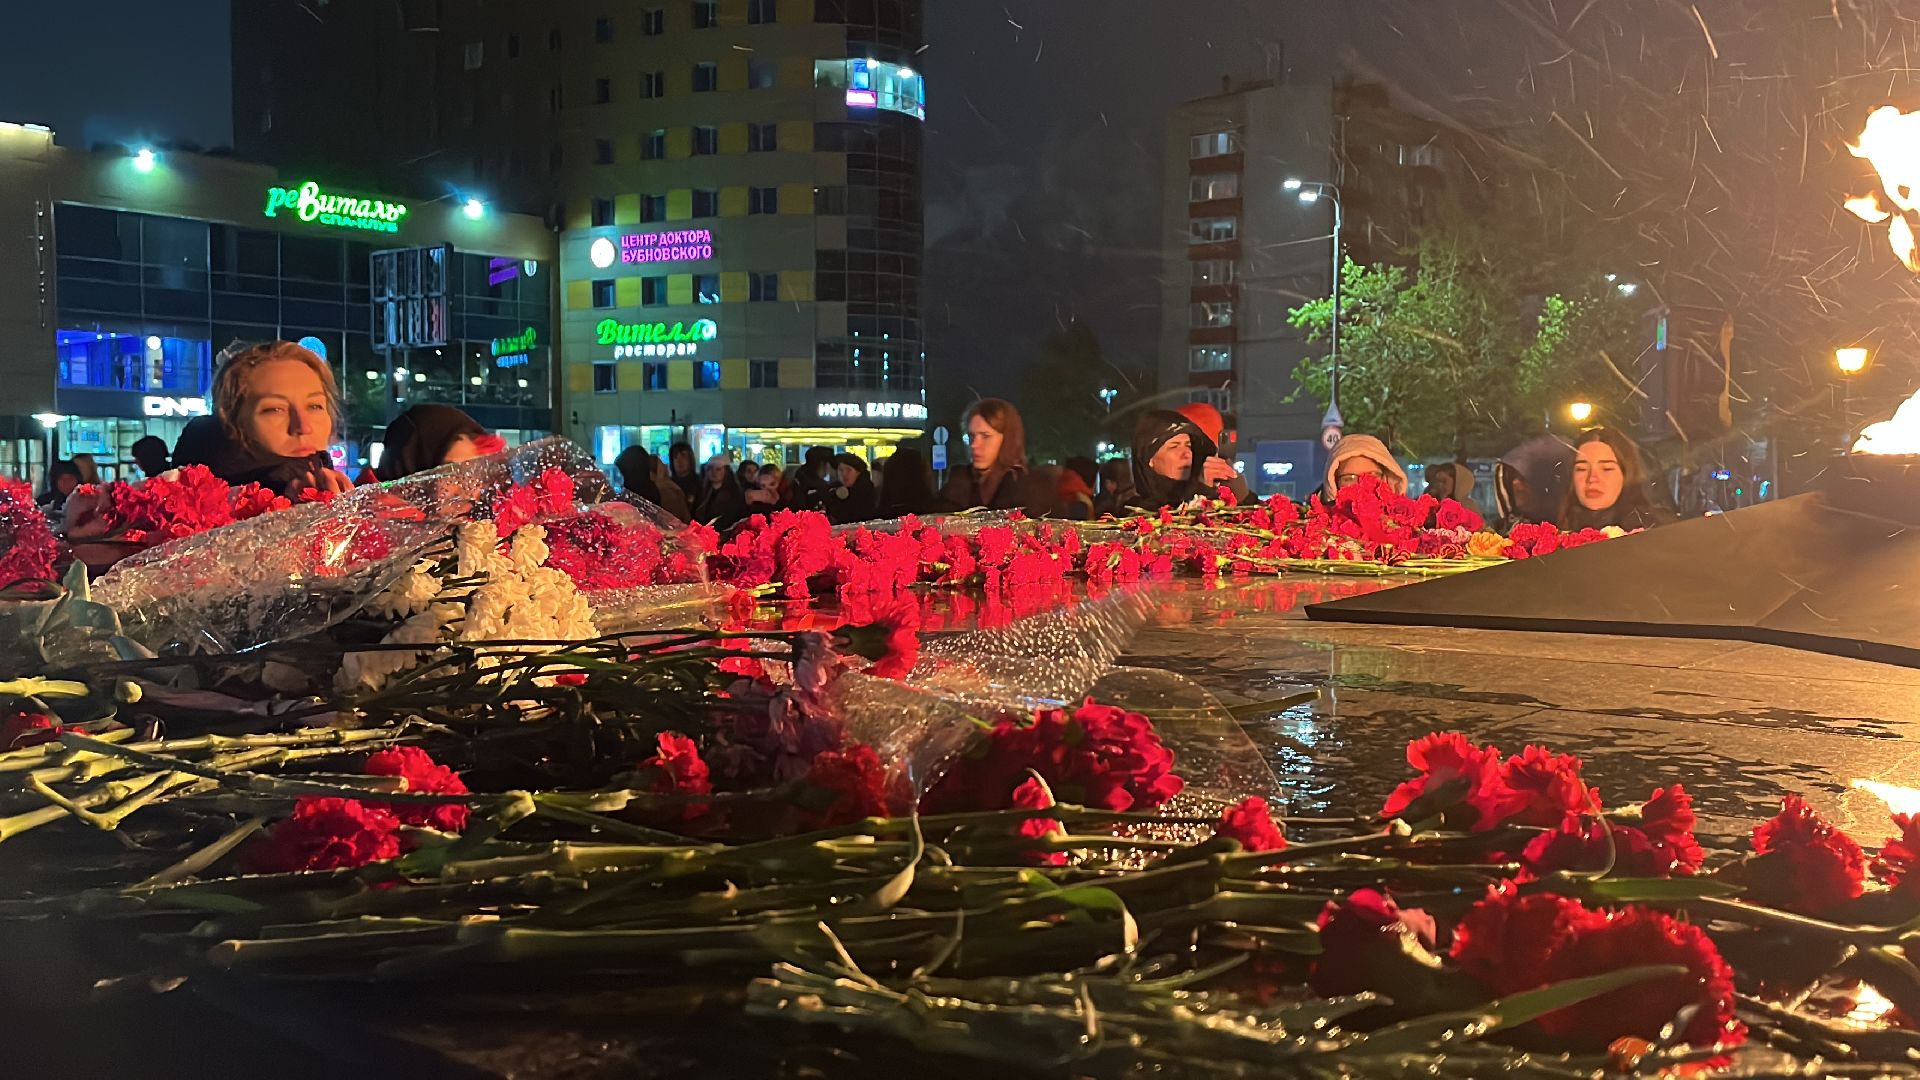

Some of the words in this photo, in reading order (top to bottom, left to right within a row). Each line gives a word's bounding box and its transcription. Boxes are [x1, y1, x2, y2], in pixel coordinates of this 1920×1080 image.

[621, 234, 658, 248] ЦЕНТР
[659, 229, 712, 246] ДОКТОРА
[621, 245, 712, 263] БУБНОВСКОГО
[614, 343, 697, 360] ресторан
[144, 396, 207, 416] DNS
[818, 403, 862, 417] HOTEL
[866, 402, 900, 417] EAST
[1327, 434, 1339, 443] 40
